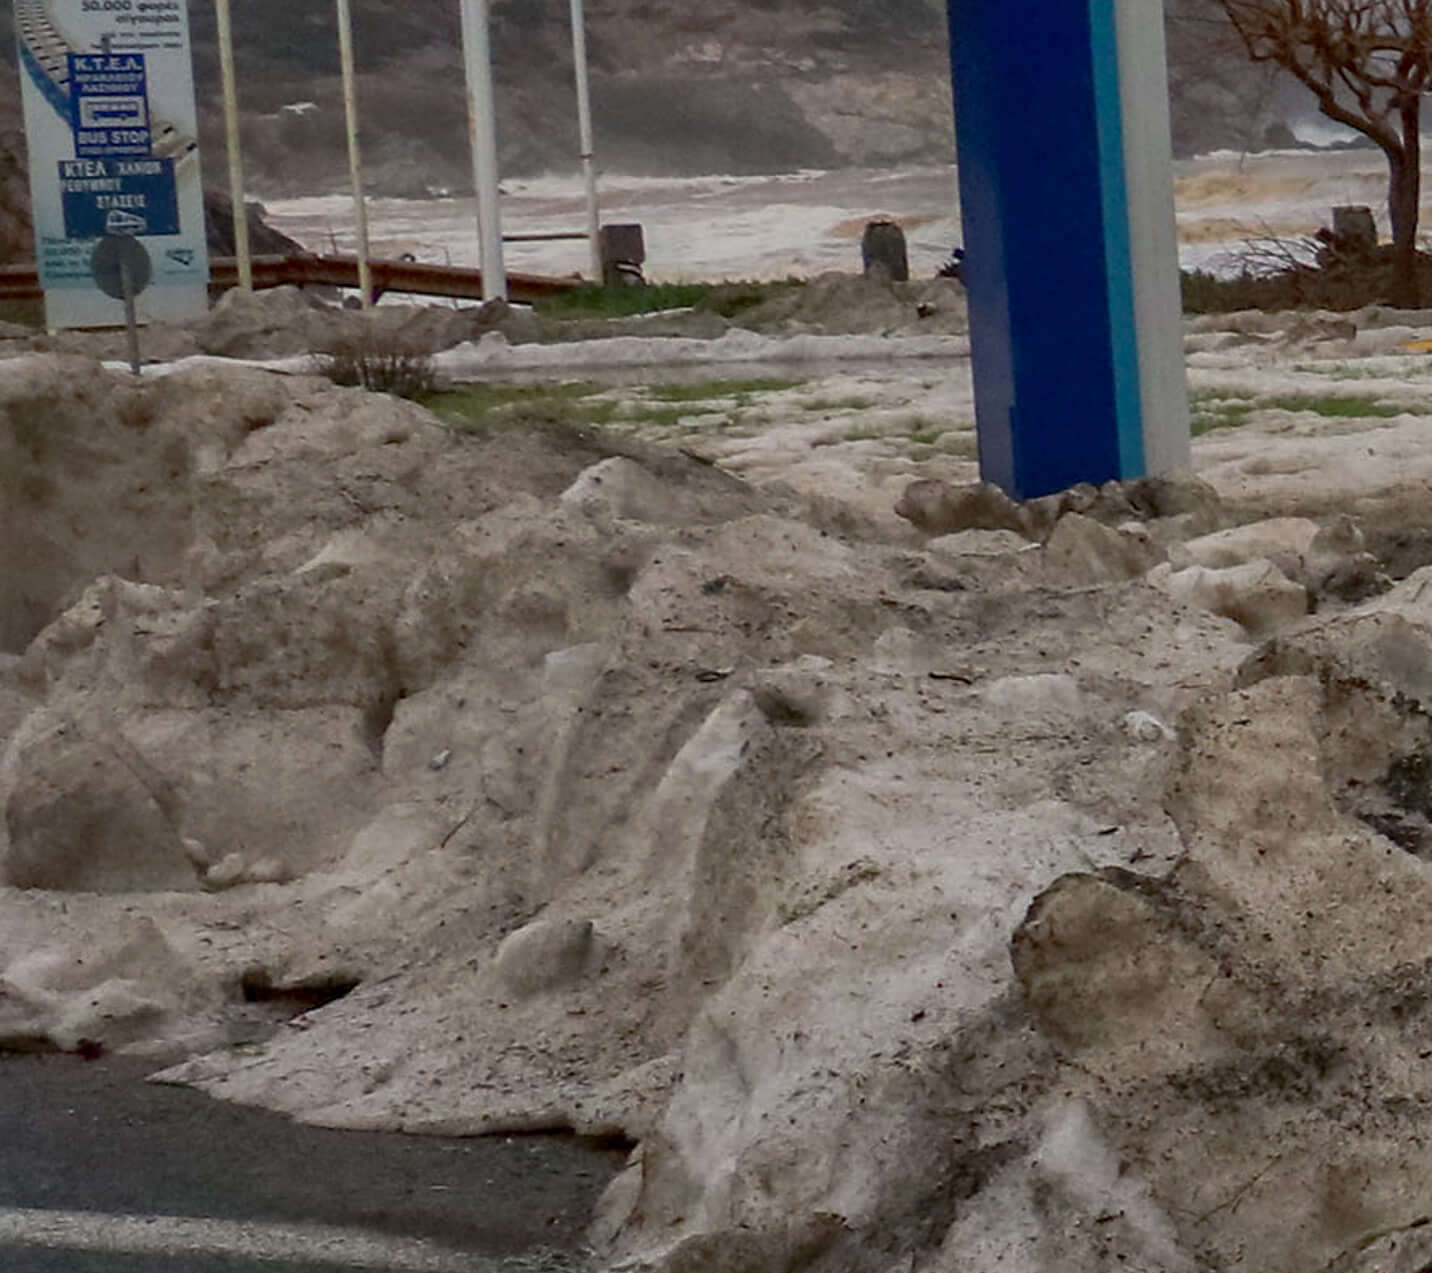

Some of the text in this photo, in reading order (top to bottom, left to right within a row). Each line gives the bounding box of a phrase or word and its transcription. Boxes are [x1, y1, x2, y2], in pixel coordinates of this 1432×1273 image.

[74, 57, 144, 71] Κ.Τ.Ε.Λ.
[79, 130, 149, 144] BUS STOP
[64, 160, 108, 177] ΚΤΕΛ
